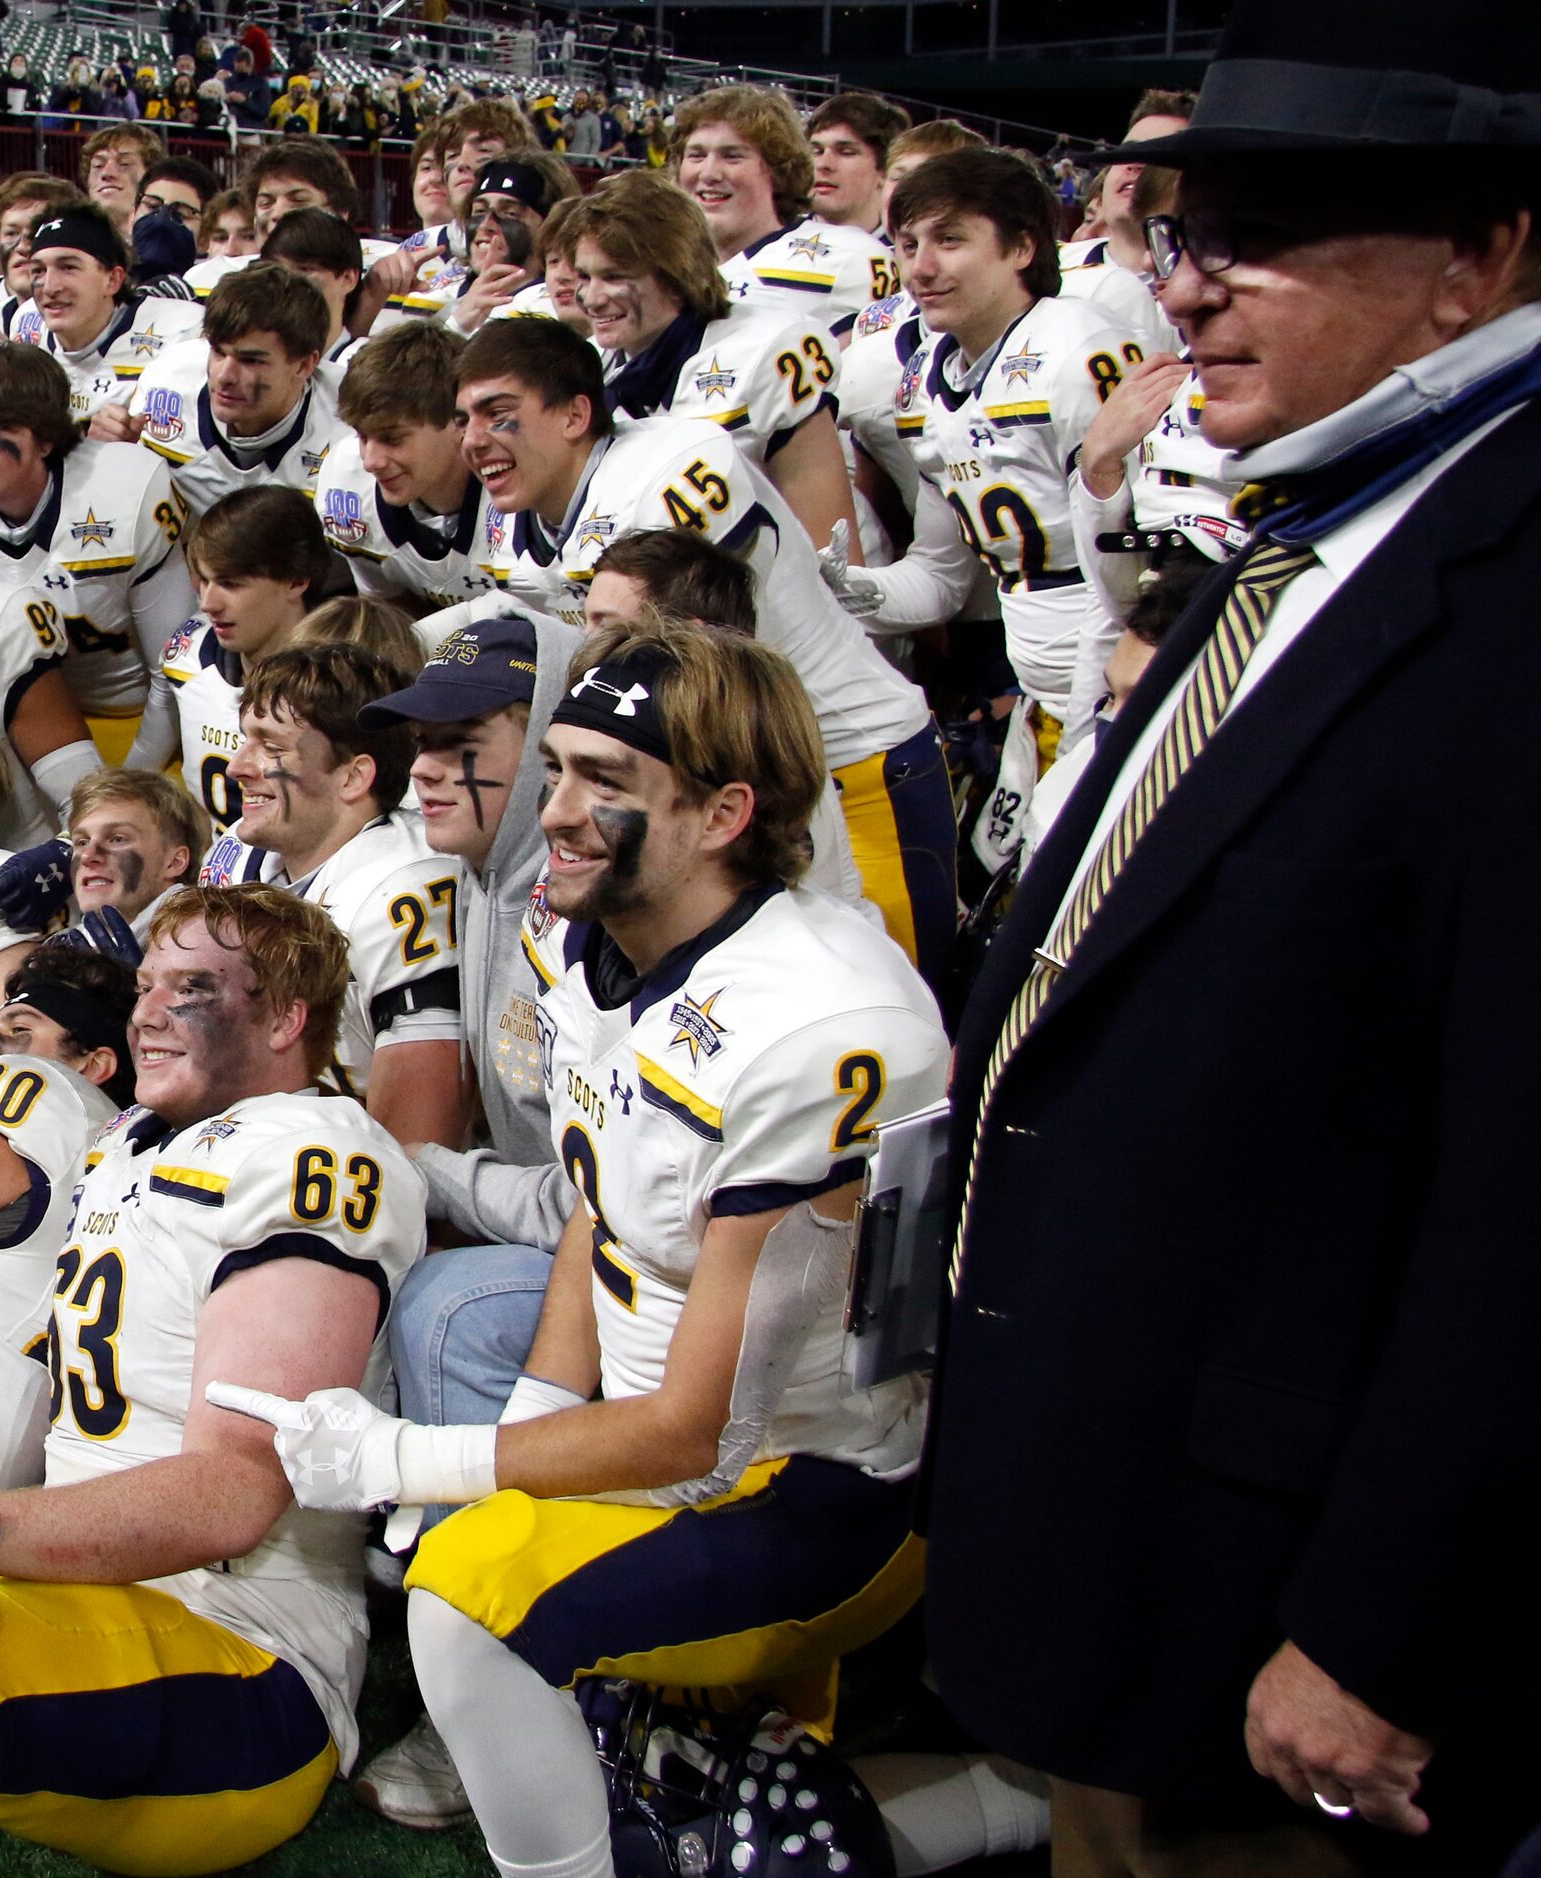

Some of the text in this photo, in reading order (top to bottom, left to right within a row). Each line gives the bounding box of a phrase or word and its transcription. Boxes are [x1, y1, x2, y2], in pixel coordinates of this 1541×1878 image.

[143, 387, 183, 417] 100
[776, 335, 835, 407] 23
[662, 458, 731, 532] 45
[201, 725, 239, 751] SCOTS
[992, 787, 1022, 825] 82
[387, 875, 460, 968] 27
[567, 1067, 605, 1132] SCOTS
[829, 1048, 887, 1153] 2
[82, 1211, 119, 1235] SCOTS
[290, 1144, 384, 1234] 63
[562, 1119, 641, 1317] 2
